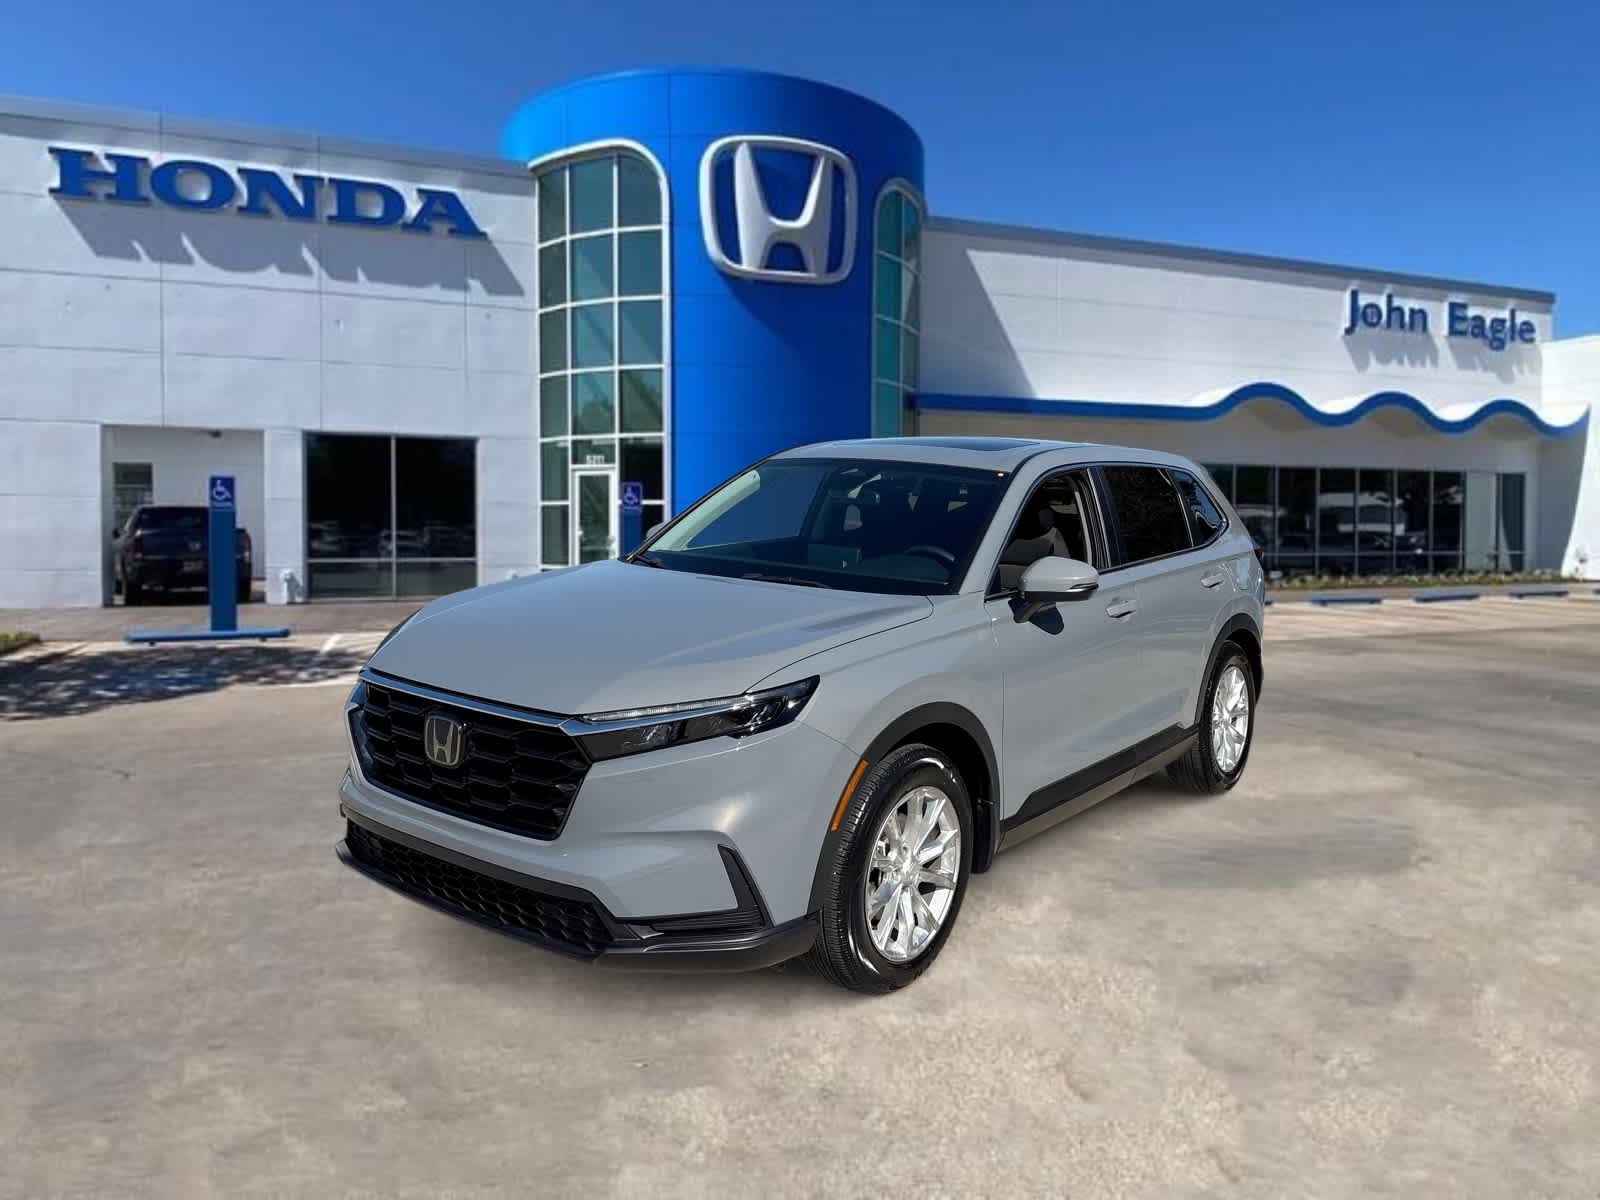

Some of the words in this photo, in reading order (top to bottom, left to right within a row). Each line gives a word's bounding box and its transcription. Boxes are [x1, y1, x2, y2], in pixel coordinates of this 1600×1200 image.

[48, 146, 489, 240] HONDA
[1344, 289, 1428, 336] John
[1448, 302, 1536, 352] Eagle
